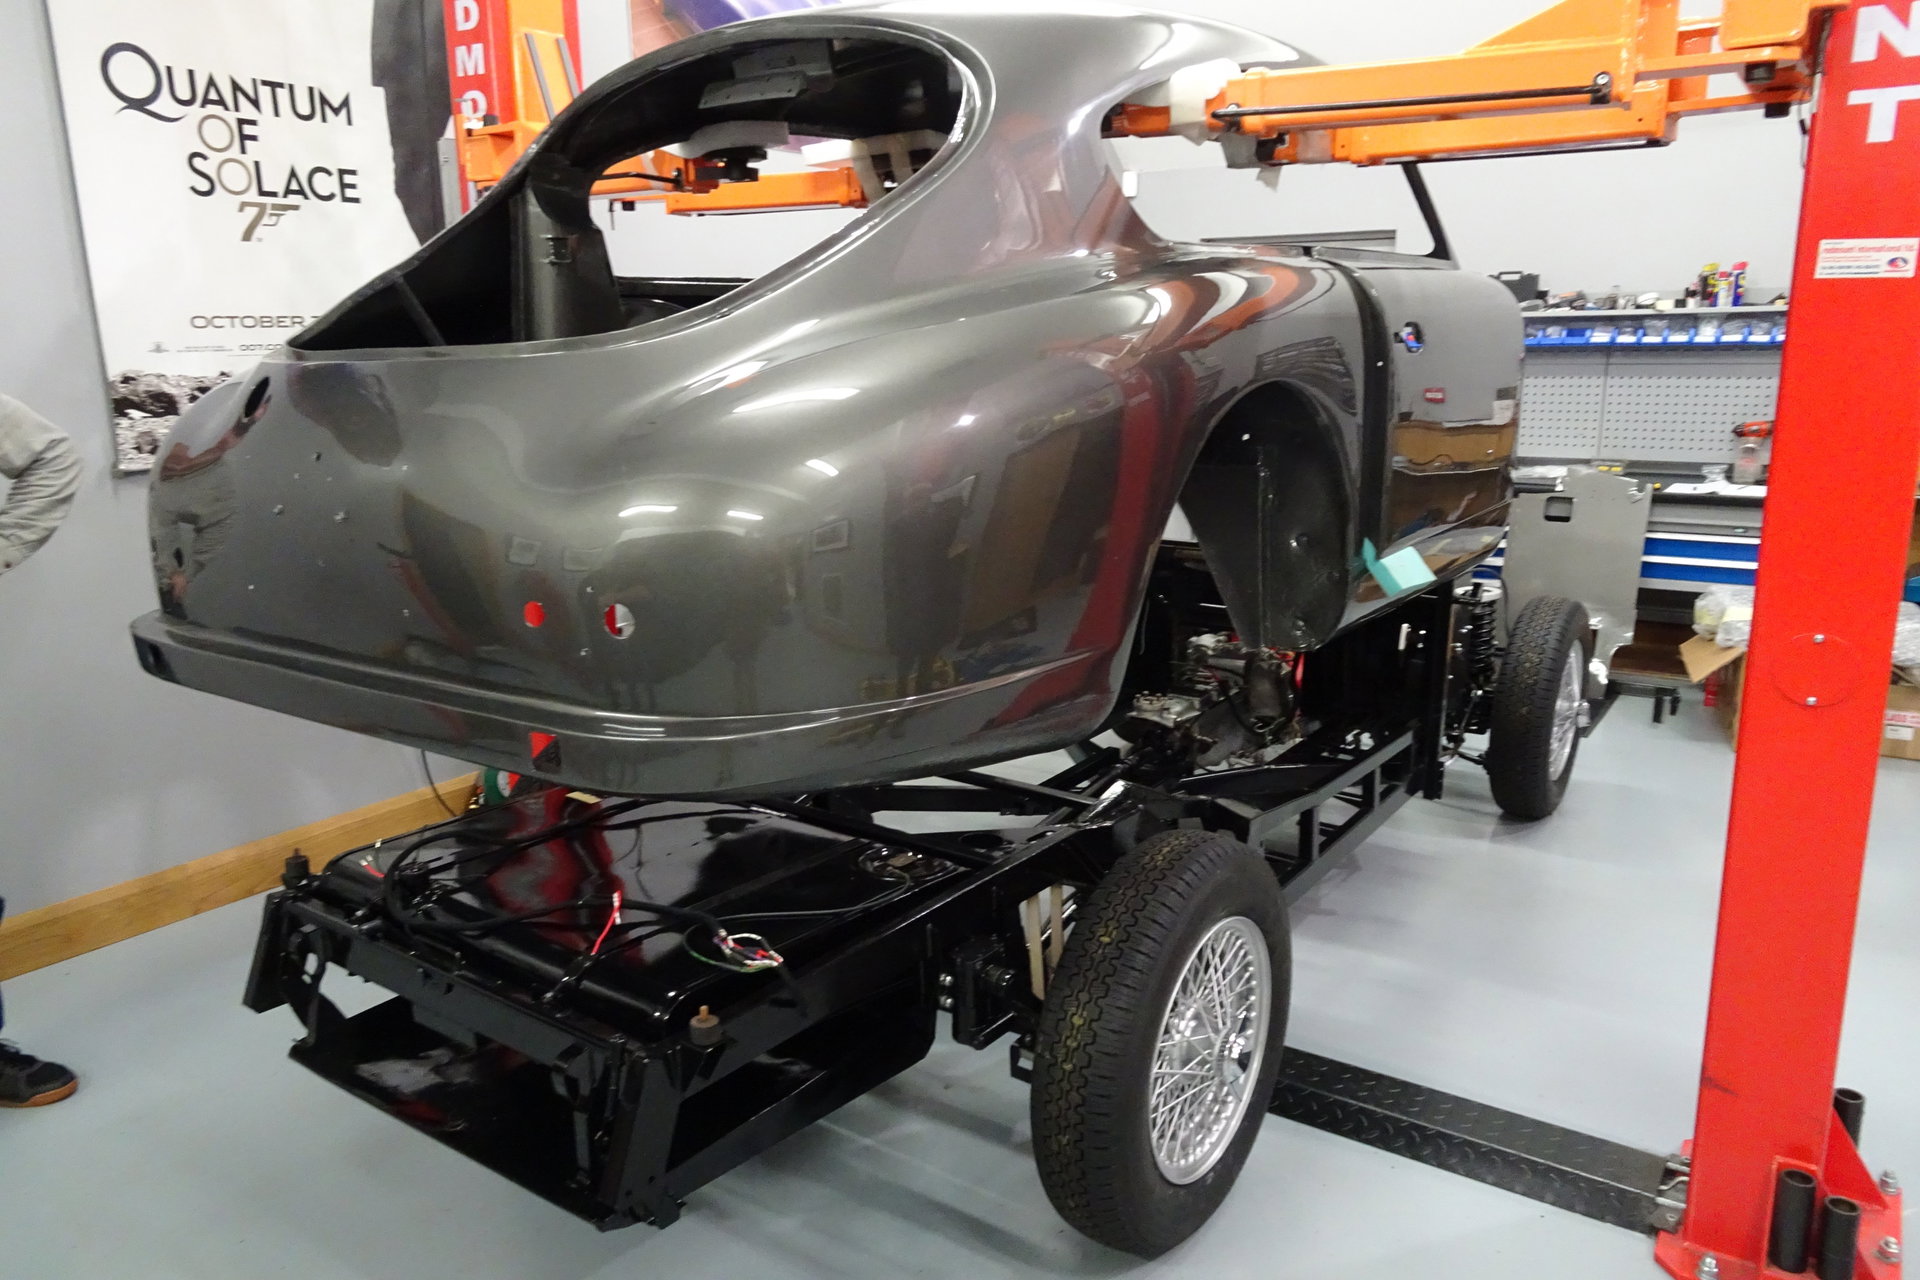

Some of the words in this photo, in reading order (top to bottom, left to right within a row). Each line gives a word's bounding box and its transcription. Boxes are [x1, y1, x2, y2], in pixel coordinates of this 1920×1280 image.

[100, 42, 353, 127] QUANTUM
[197, 113, 259, 155] OF
[187, 151, 361, 204] SOLACE
[190, 315, 305, 329] OCTOBER
